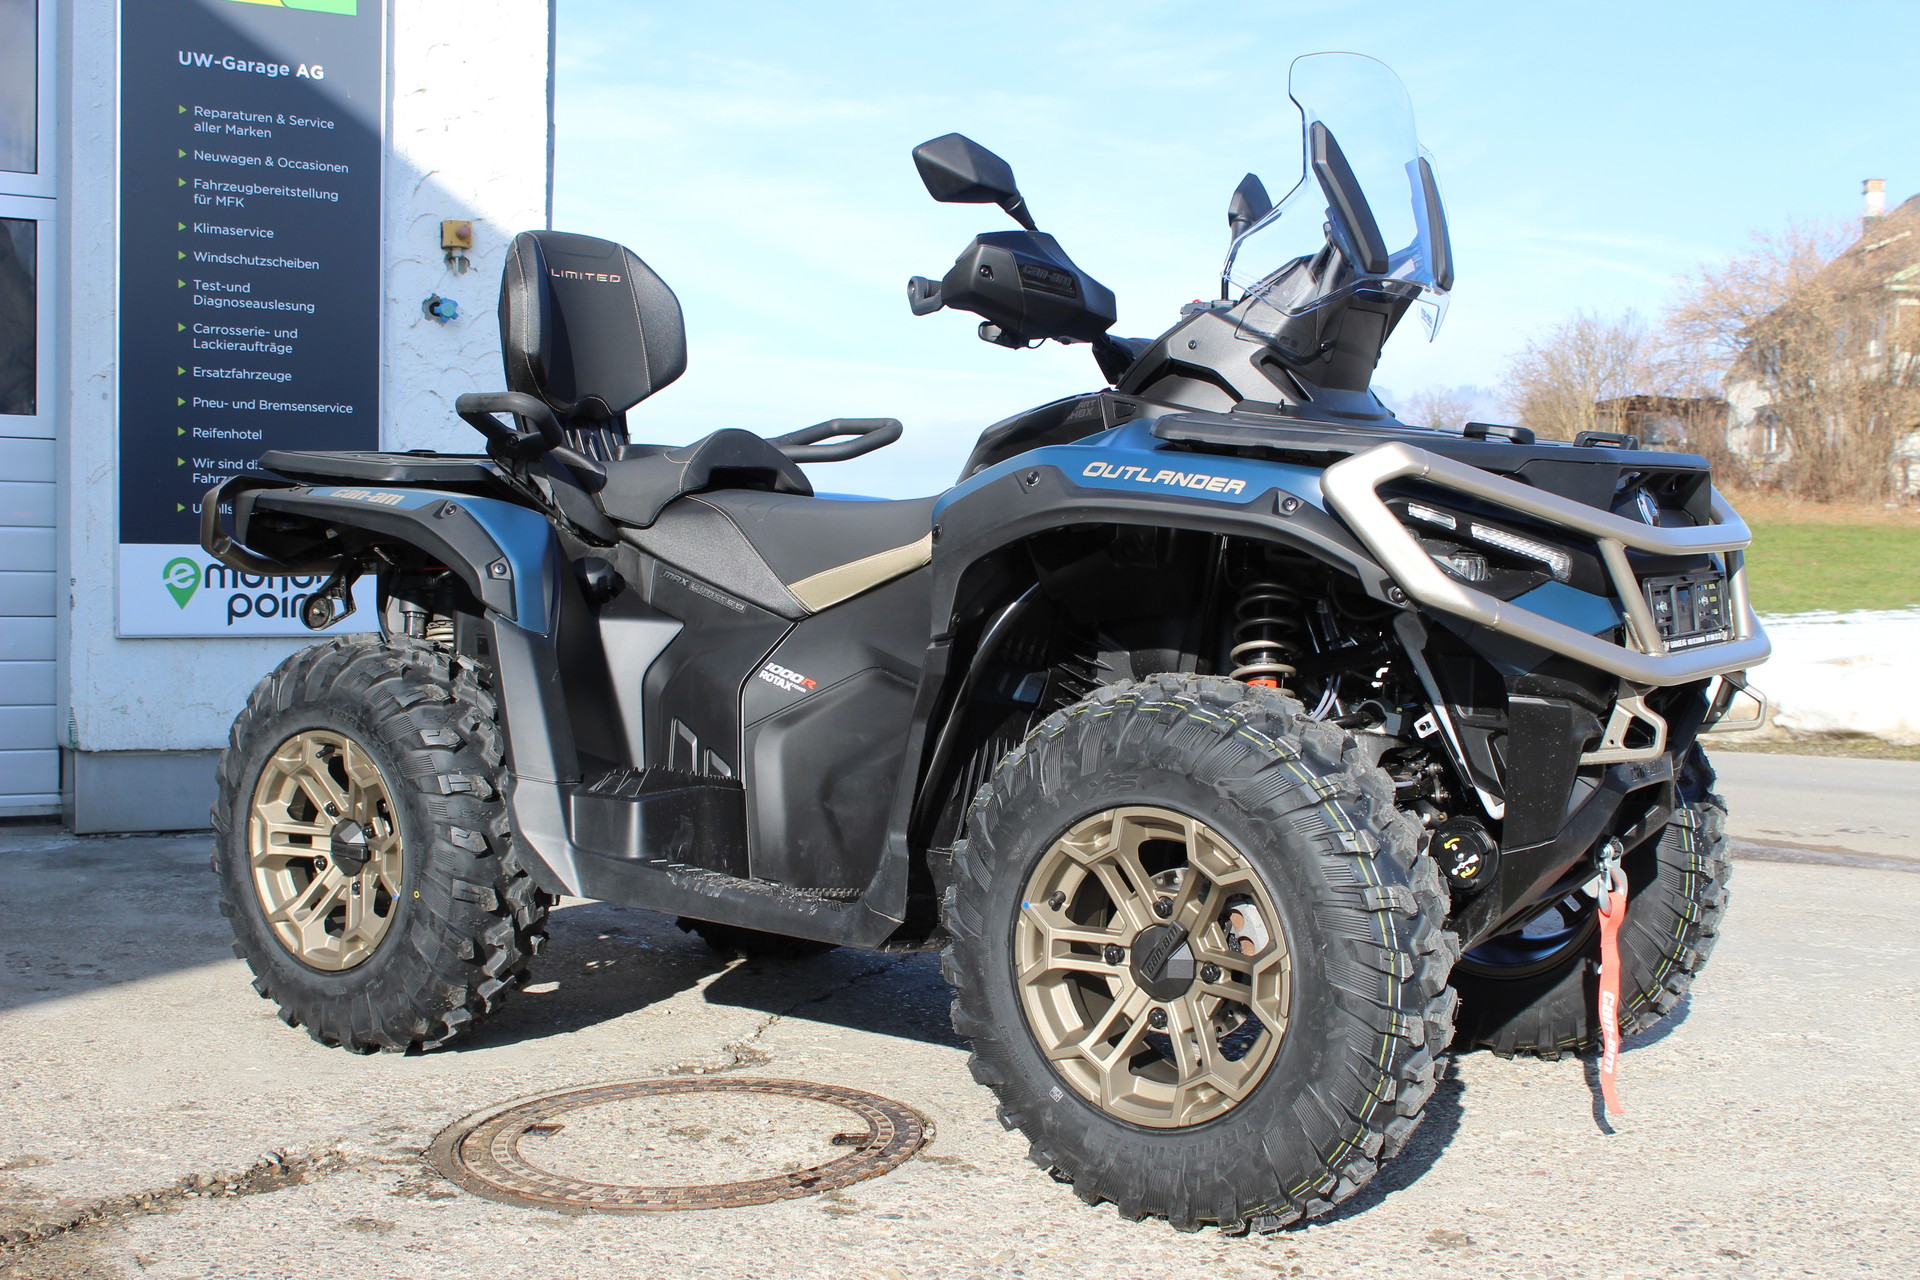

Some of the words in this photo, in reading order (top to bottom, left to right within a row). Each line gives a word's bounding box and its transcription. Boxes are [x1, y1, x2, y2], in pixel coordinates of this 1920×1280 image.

[179, 51, 290, 78] UW-Garage
[296, 64, 325, 80] AG
[194, 105, 273, 124] Reparaturen
[276, 114, 286, 125] &
[289, 115, 335, 130] Service
[193, 122, 222, 134] aller
[225, 124, 272, 138] Marken
[194, 150, 262, 167] Neuwagen
[265, 156, 274, 167] &
[277, 157, 349, 174] Occasionen
[194, 178, 339, 202] Fahrzeugbereitstellung
[193, 194, 212, 206] für
[216, 196, 245, 208] MFK
[194, 222, 274, 239] Klimaservice
[194, 251, 320, 270] Windschutzscheiben
[551, 268, 621, 283] LIMITED
[193, 280, 251, 293] Test-und
[193, 295, 315, 314] Diagnoseauslesung
[193, 323, 271, 337] Carrosserie-
[274, 328, 298, 339] und
[193, 338, 293, 355] Lackieraufträge
[193, 366, 292, 383] Ersatzfahrzeuge
[193, 397, 229, 409] Pneu-
[232, 399, 256, 410] und
[259, 400, 353, 414] Bremsenservice
[193, 427, 262, 440] Reifenhotel
[192, 458, 216, 469] Wir
[218, 459, 244, 469] sind
[246, 459, 264, 471] di
[192, 473, 232, 484] Fahrz
[1082, 461, 1247, 495] OUTLANDER
[662, 570, 690, 586] MAX
[758, 669, 793, 692] ROTAX
[764, 662, 817, 690] 1000R
